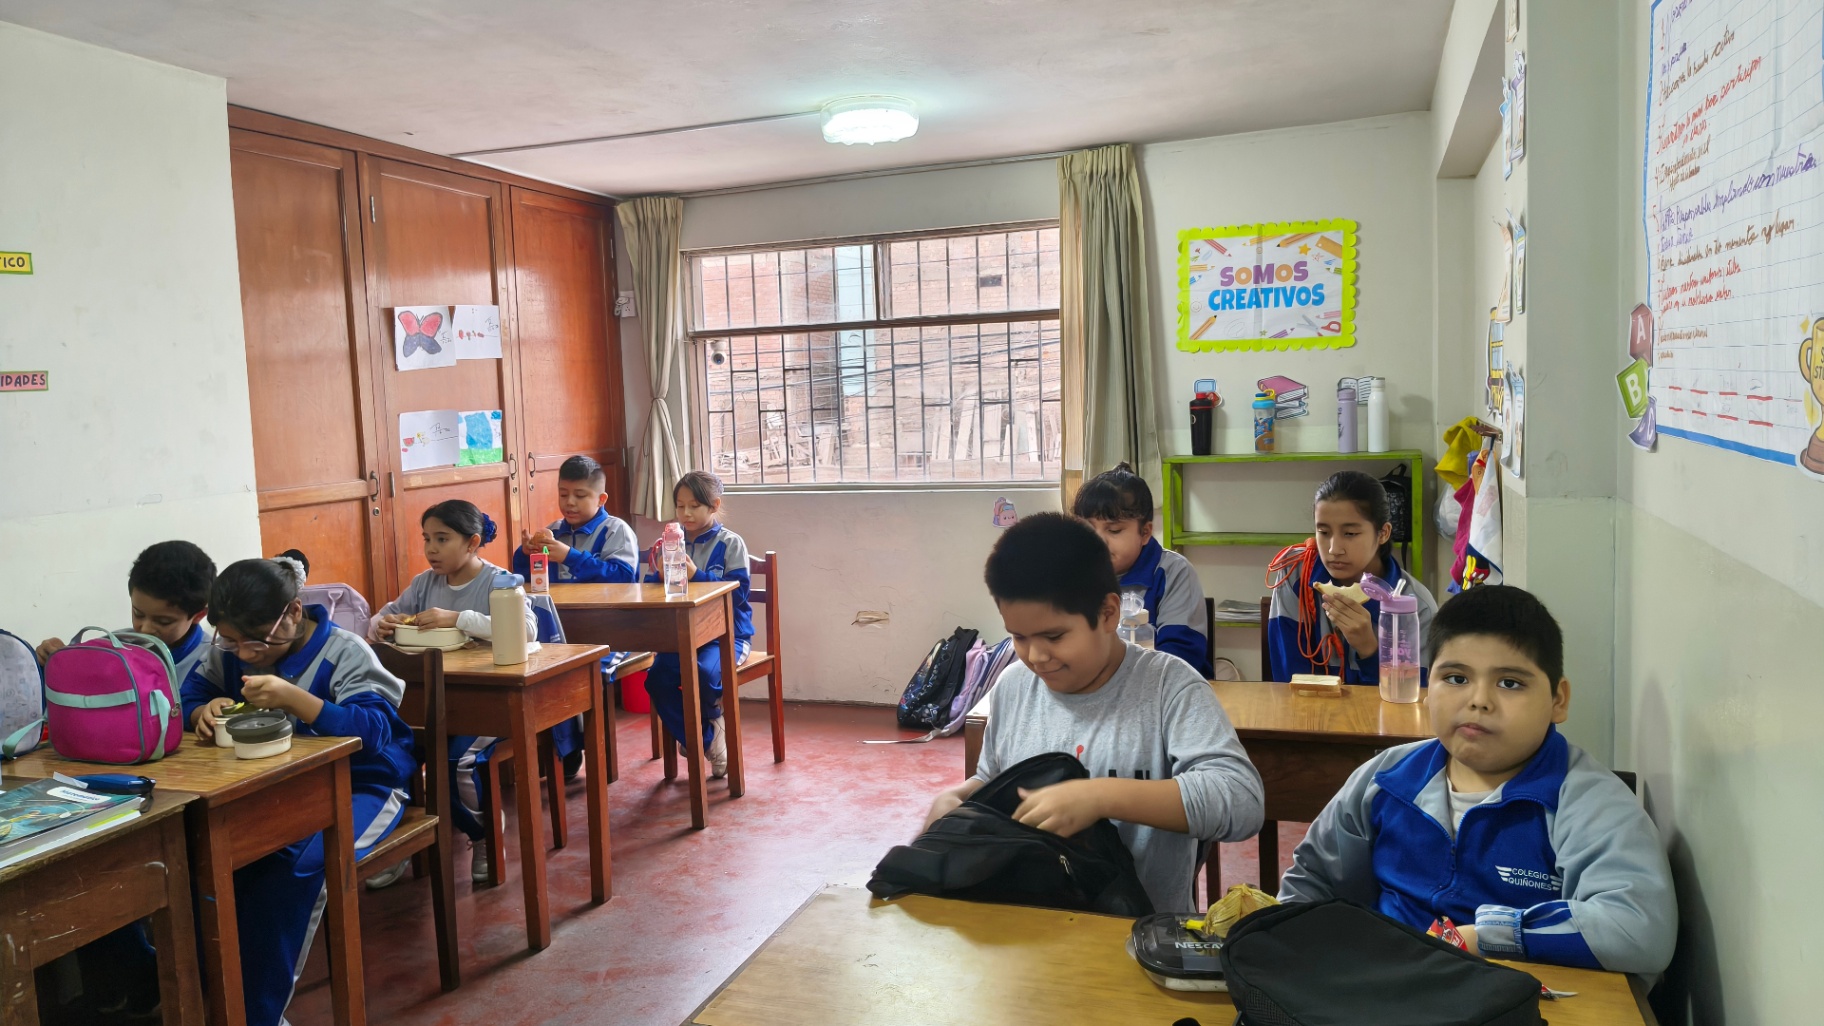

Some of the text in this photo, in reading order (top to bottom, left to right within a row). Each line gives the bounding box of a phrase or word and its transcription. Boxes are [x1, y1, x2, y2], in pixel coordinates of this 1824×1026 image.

[1220, 261, 1309, 287] SOMOS
[1208, 283, 1325, 311] CREATIVOS
[1636, 314, 1647, 345] A
[0, 373, 46, 387] IDADES
[1625, 373, 1643, 406] B
[1508, 876, 1552, 891] QUIÑONES
[1511, 868, 1549, 880] COLEGIO
[1175, 941, 1224, 949] NESCA
